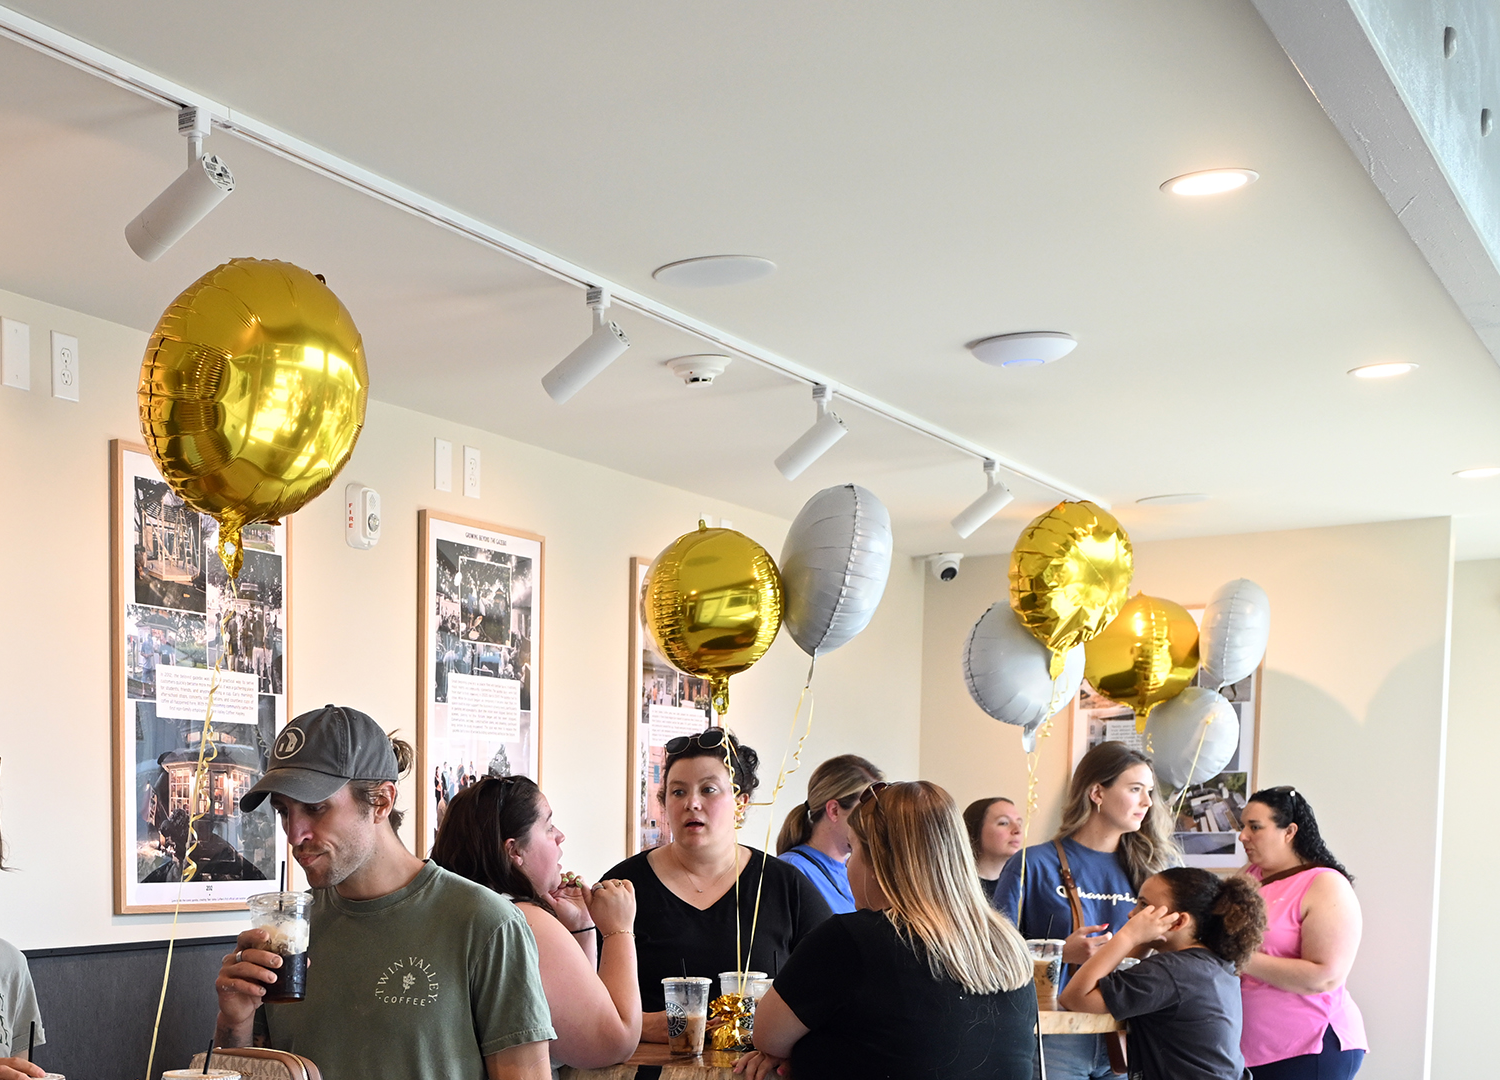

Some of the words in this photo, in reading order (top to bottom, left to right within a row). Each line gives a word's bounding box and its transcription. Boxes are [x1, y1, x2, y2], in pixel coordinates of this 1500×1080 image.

[374, 959, 404, 997] TWIN
[409, 956, 439, 1002] VALLEY
[383, 996, 426, 1007] COFFEE
